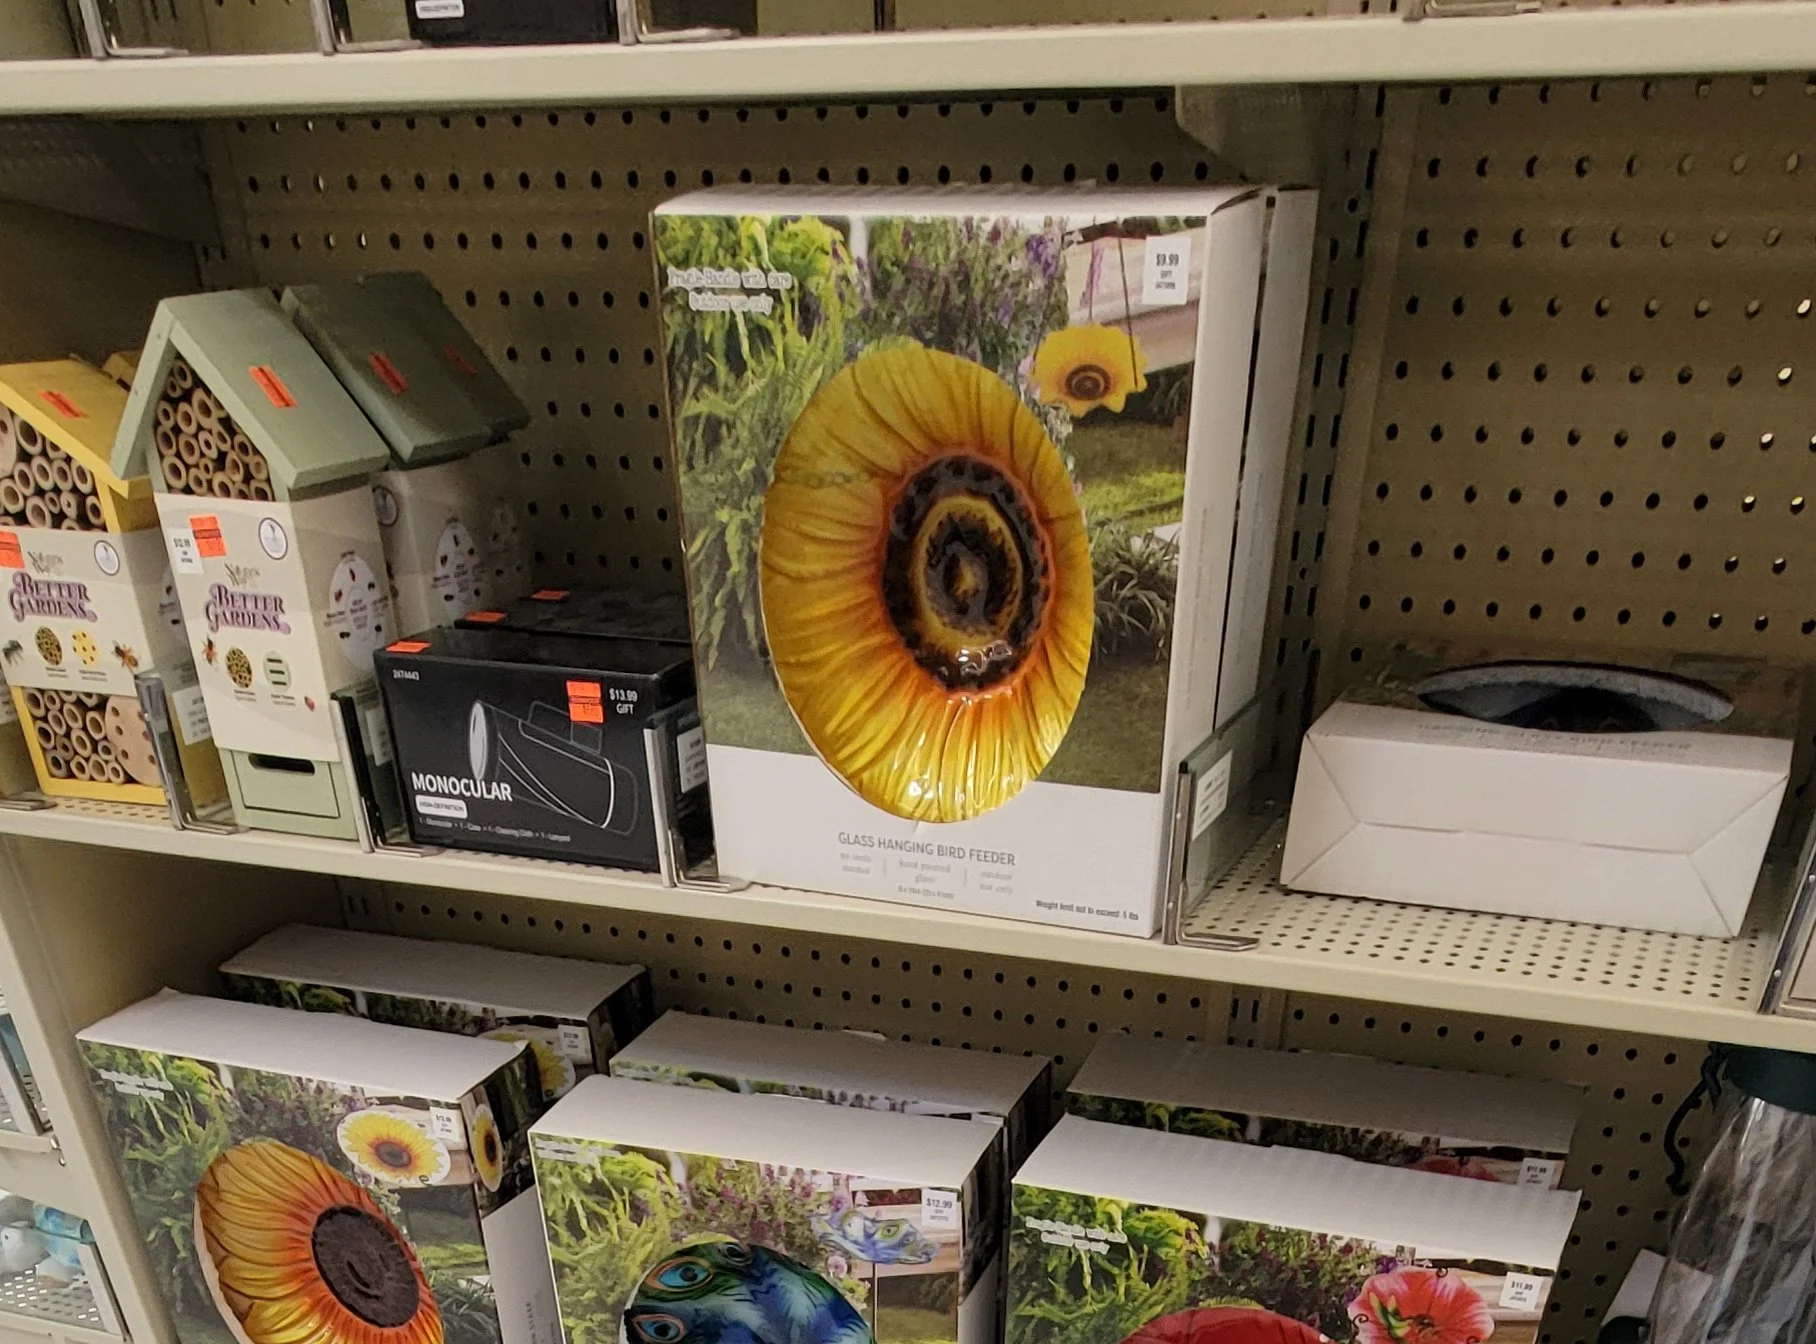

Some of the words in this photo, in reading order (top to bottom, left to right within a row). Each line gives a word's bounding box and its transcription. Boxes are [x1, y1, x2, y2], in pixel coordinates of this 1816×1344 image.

[17, 571, 92, 602] BETTER
[212, 583, 286, 615] BETTER
[9, 589, 89, 622] GARDENS
[204, 601, 283, 633] GARDENS
[609, 688, 638, 702] $13.99
[616, 703, 634, 715] GIFT
[411, 772, 513, 802] MONOCULAR
[838, 832, 875, 848] GLASS
[878, 837, 934, 855] HANGING
[937, 844, 966, 859] BIRD
[969, 848, 1016, 866] FEEDER
[926, 1198, 952, 1209] $12.99
